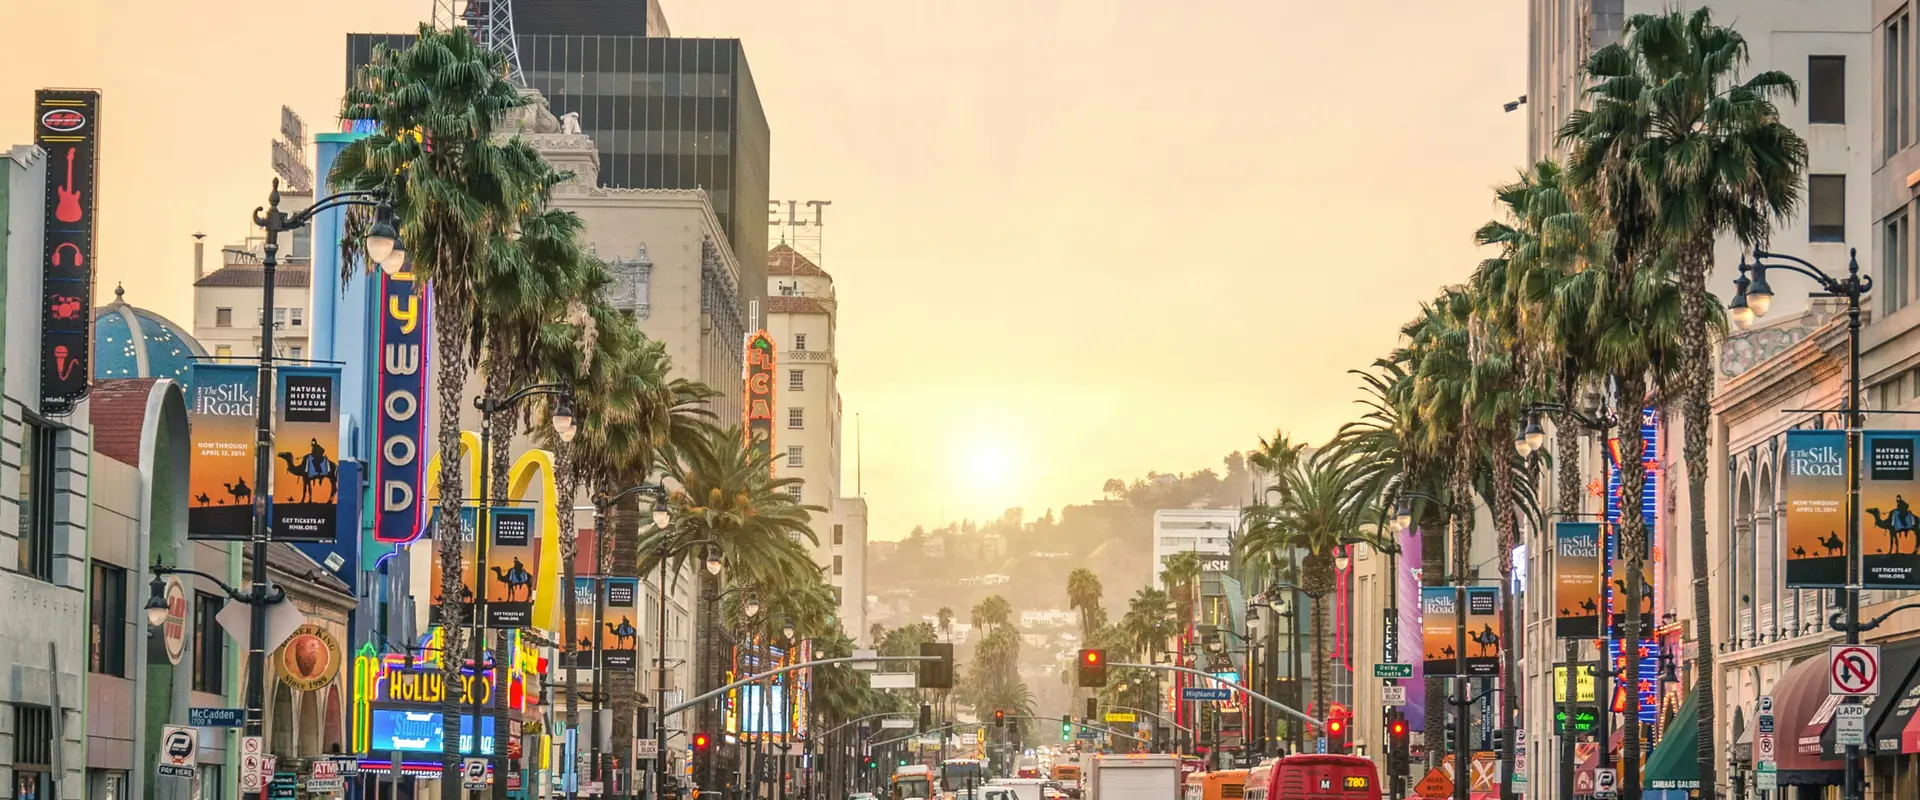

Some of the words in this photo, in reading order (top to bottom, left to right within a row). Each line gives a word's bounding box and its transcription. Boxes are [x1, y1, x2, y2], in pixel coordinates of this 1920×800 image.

[218, 383, 250, 402] Silk
[203, 396, 253, 416] Road
[1808, 446, 1838, 464] Silk
[1796, 457, 1843, 476] Road
[1572, 535, 1594, 548] Silk
[1563, 544, 1597, 557] Road
[1435, 596, 1451, 606] Silk
[1428, 603, 1455, 614] Road
[1186, 690, 1215, 698] Highland
[1217, 690, 1227, 698] Av
[191, 709, 234, 719] McCadden
[1837, 706, 1863, 715] LAPD
[175, 768, 193, 776] HERE
[314, 762, 337, 773] ATM
[1347, 777, 1365, 788] 780
